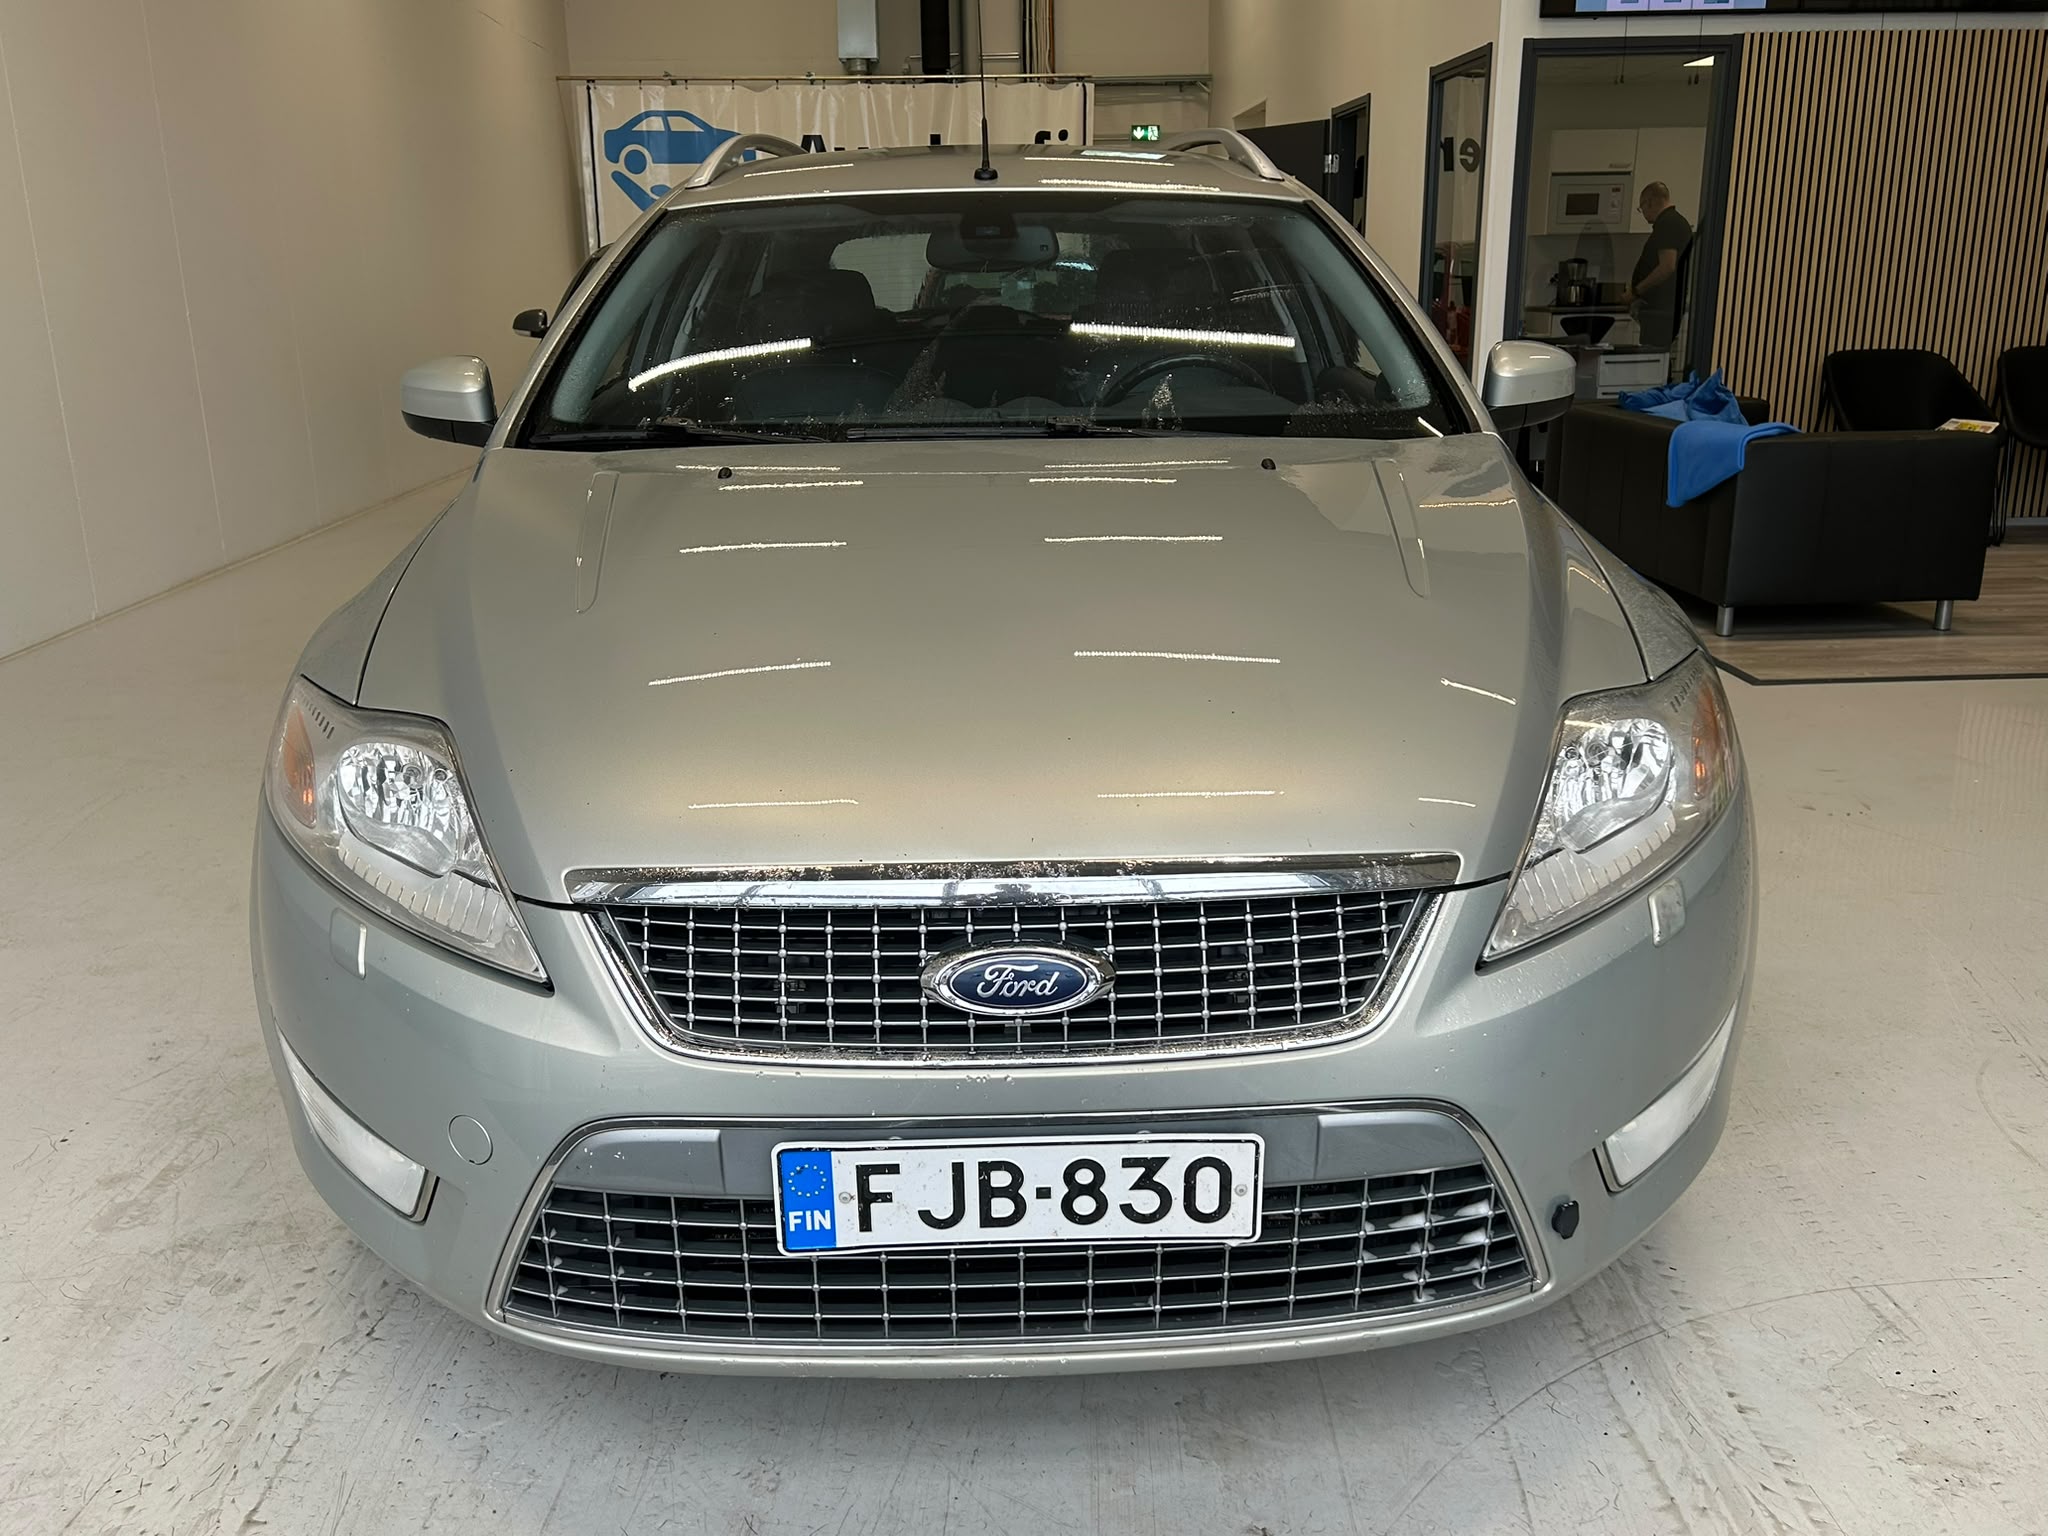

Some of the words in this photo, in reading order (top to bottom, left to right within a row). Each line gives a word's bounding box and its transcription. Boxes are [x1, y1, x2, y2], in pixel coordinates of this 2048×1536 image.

[976, 964, 1060, 998] Ford
[855, 1156, 1233, 1233] FJB-830
[788, 1209, 832, 1232] FIN
